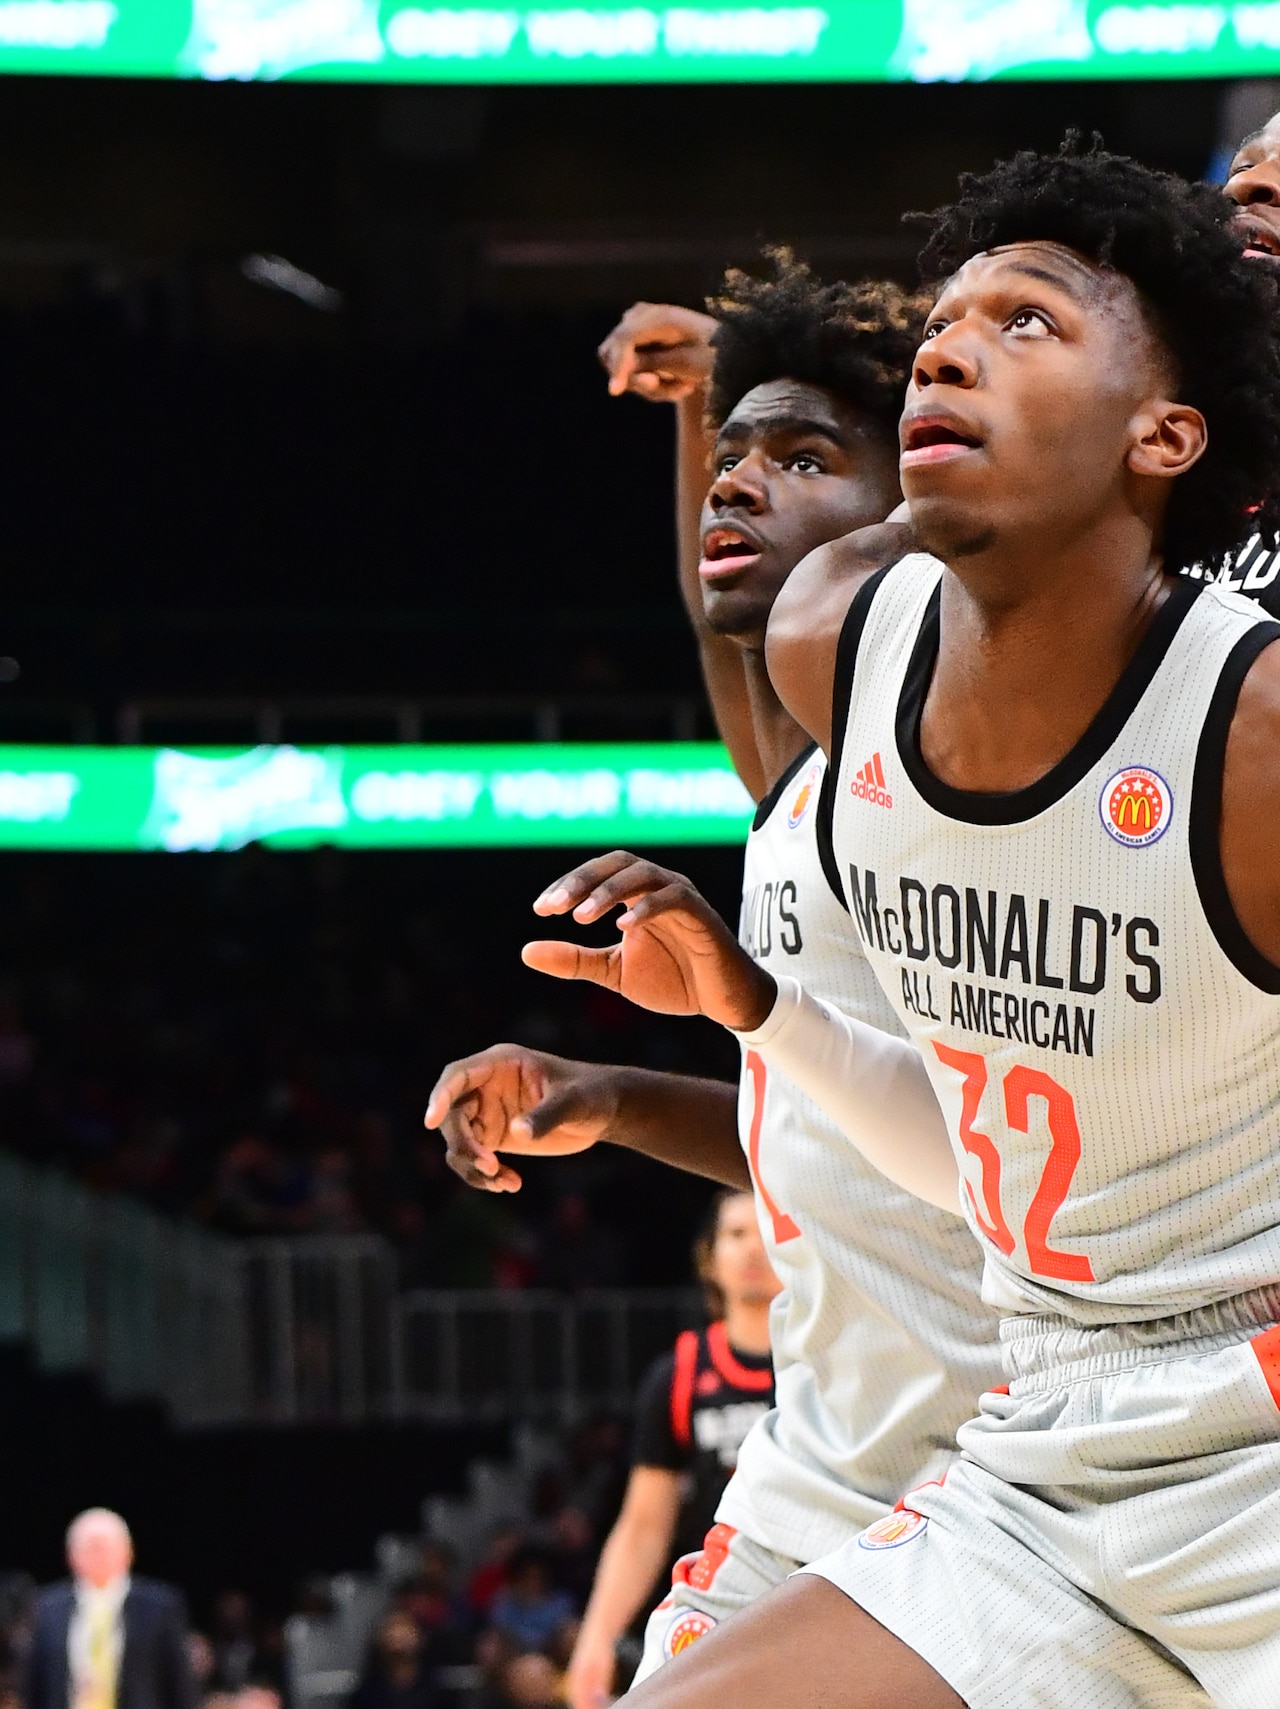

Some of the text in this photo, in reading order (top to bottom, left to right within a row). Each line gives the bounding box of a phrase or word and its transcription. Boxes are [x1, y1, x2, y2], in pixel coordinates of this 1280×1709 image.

[850, 780, 894, 810] adidas
[849, 862, 1163, 1005] McDONALD'S
[901, 966, 1096, 1058] ALL AMERICAN
[930, 1039, 1097, 1282] 32
